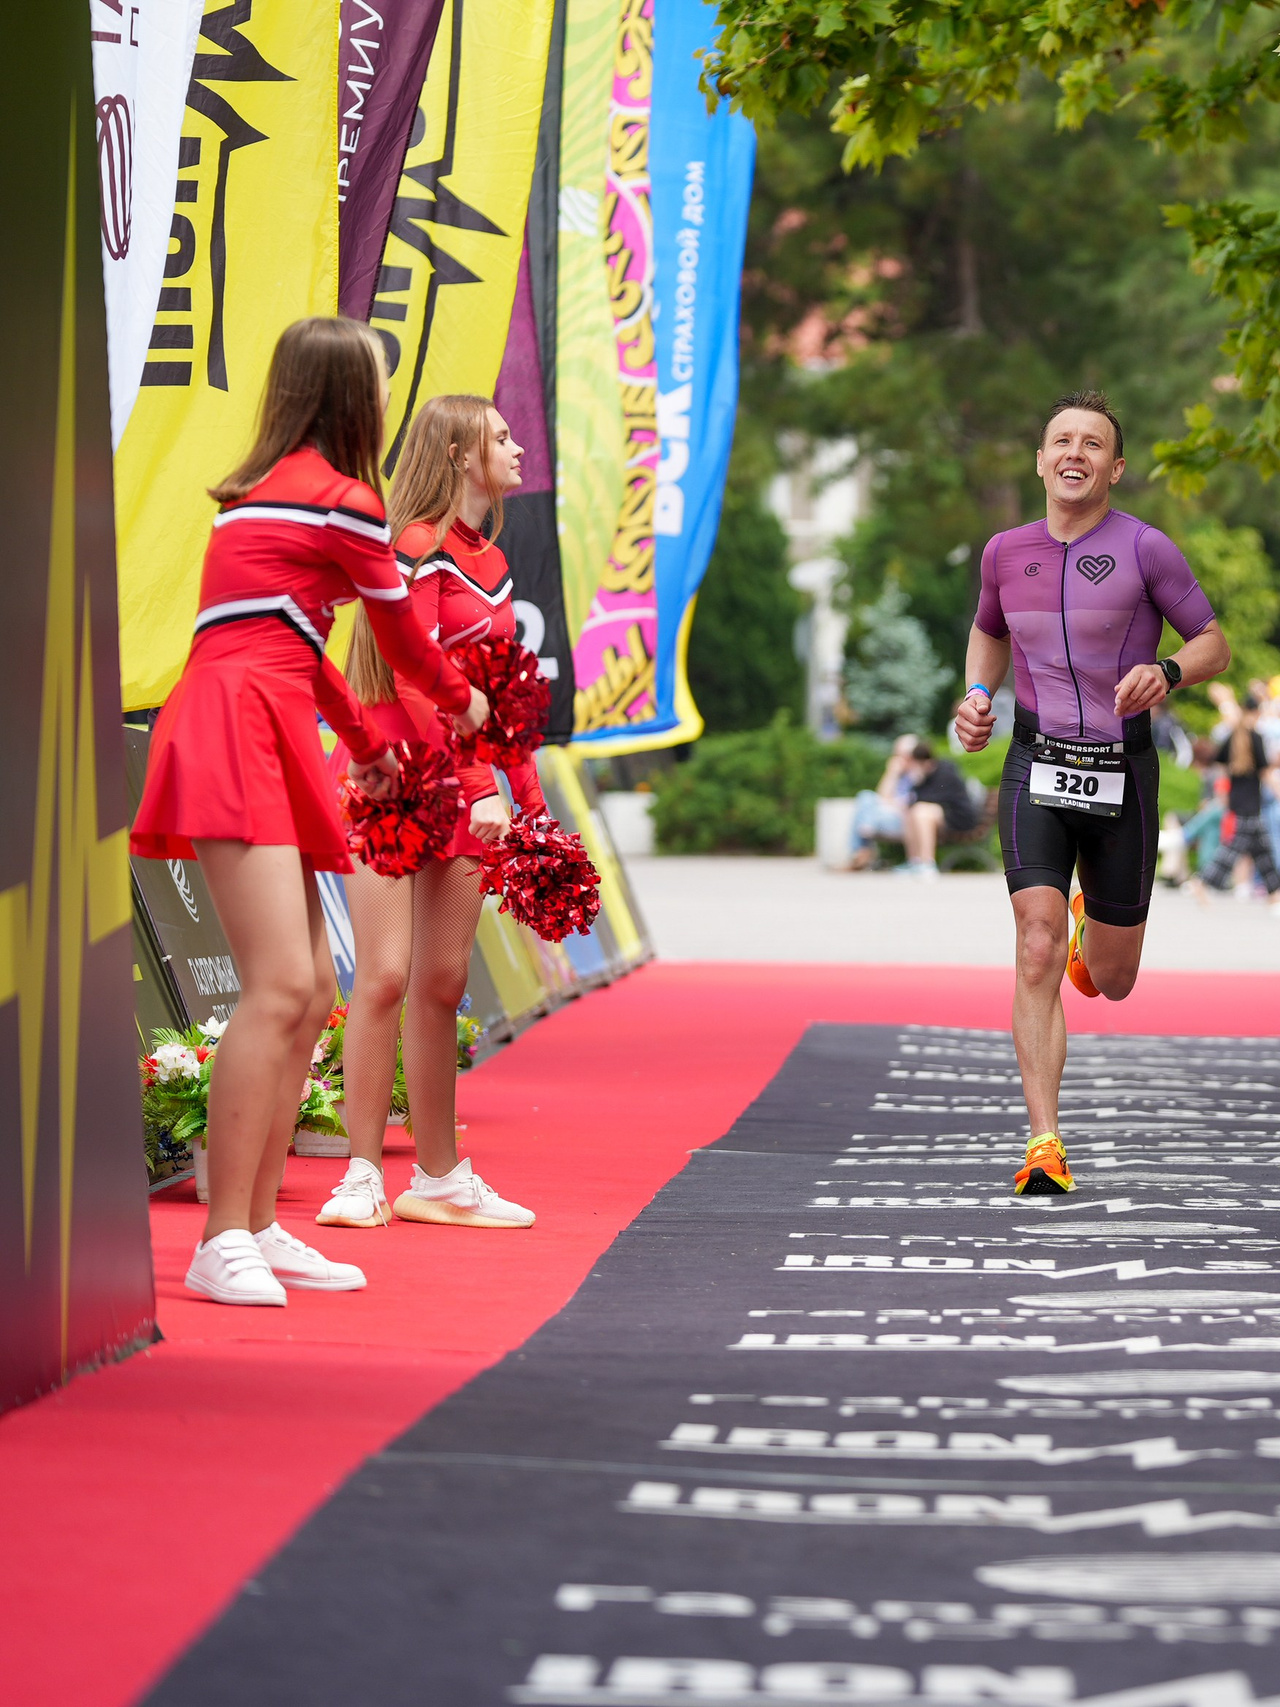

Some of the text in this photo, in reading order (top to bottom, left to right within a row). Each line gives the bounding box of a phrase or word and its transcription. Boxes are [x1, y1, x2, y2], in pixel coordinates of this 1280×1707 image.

[672, 160, 706, 383] СТРАХОВОЙ ДОМ
[1053, 771, 1099, 797] 320
[1060, 798, 1091, 810] VLADIMIR
[812, 1196, 1052, 1206] IRON
[783, 1254, 1056, 1270] IRON
[739, 1333, 1056, 1347] IRON
[668, 1423, 1052, 1451] IRON
[629, 1481, 1052, 1519] IRON
[527, 1653, 1077, 1706] IRON
